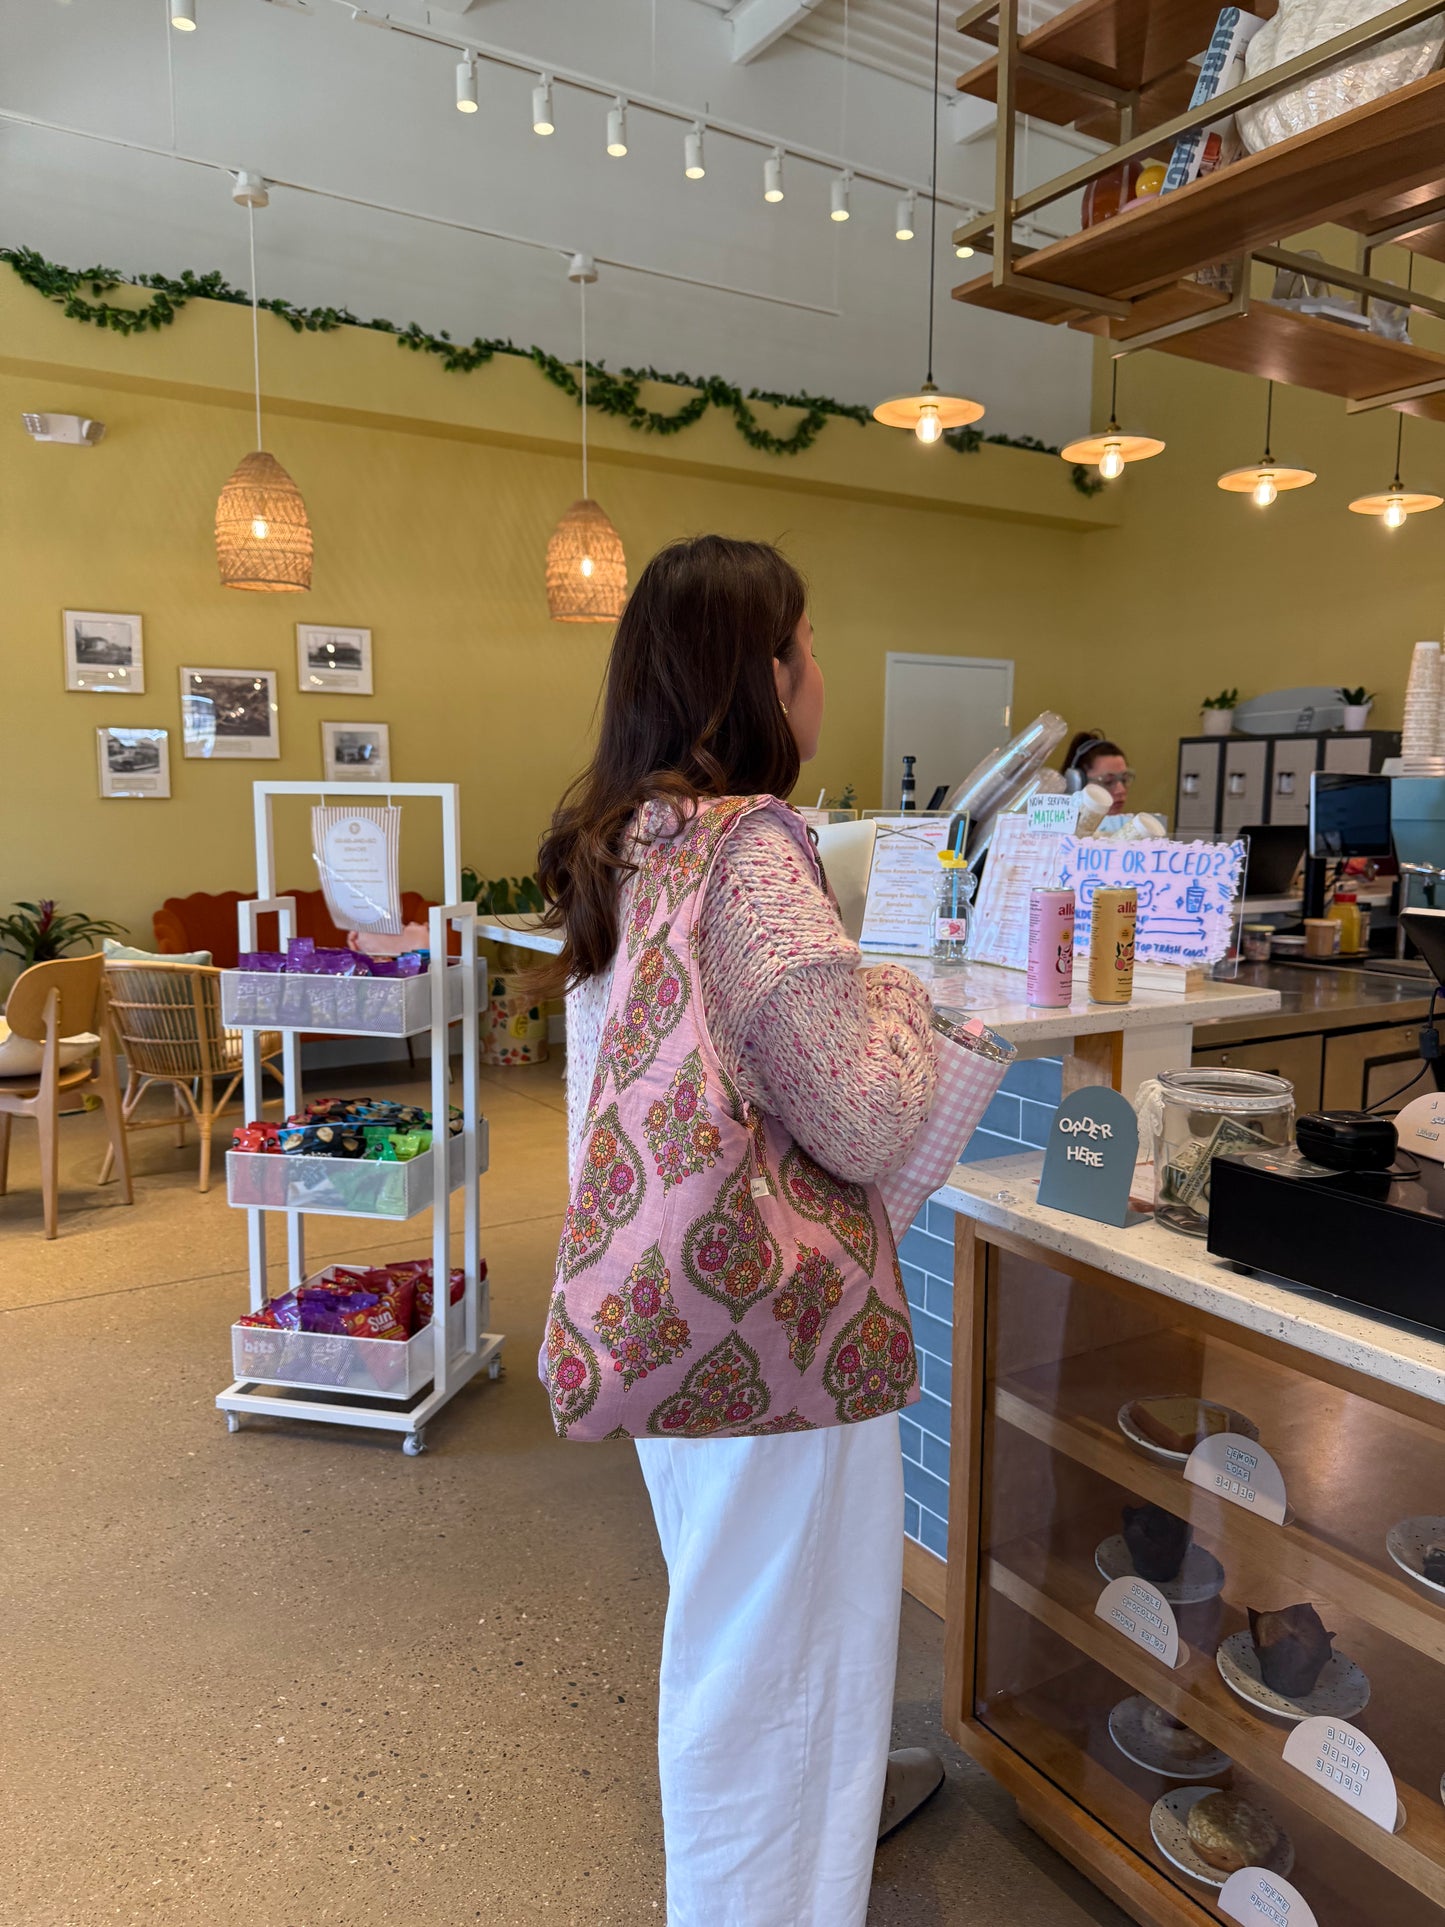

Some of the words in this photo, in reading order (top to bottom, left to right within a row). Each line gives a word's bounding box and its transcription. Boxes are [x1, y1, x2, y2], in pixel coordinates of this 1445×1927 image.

[1200, 7, 1240, 94] SURF
[1030, 796, 1044, 807] NOW
[1047, 796, 1070, 806] SERVING
[1077, 848, 1117, 872] HOT
[1122, 850, 1146, 873] OR
[1151, 850, 1226, 877] ICED?
[1153, 943, 1182, 955] TRASH
[1059, 1116, 1114, 1140] ORDER
[1067, 1146, 1104, 1167] HERE
[367, 1311, 393, 1332] Sun
[1225, 1446, 1258, 1468] LEMON
[1225, 1462, 1250, 1482] LOAF
[1131, 1584, 1161, 1610] DOUBLE
[1111, 1608, 1136, 1632] CHUNK
[1327, 1727, 1365, 1756] BLUE
[1321, 1741, 1369, 1780] BERRY
[1315, 1758, 1362, 1796] $3.95
[1258, 1878, 1290, 1914] CREME
[1249, 1892, 1288, 1926] BRULEE
